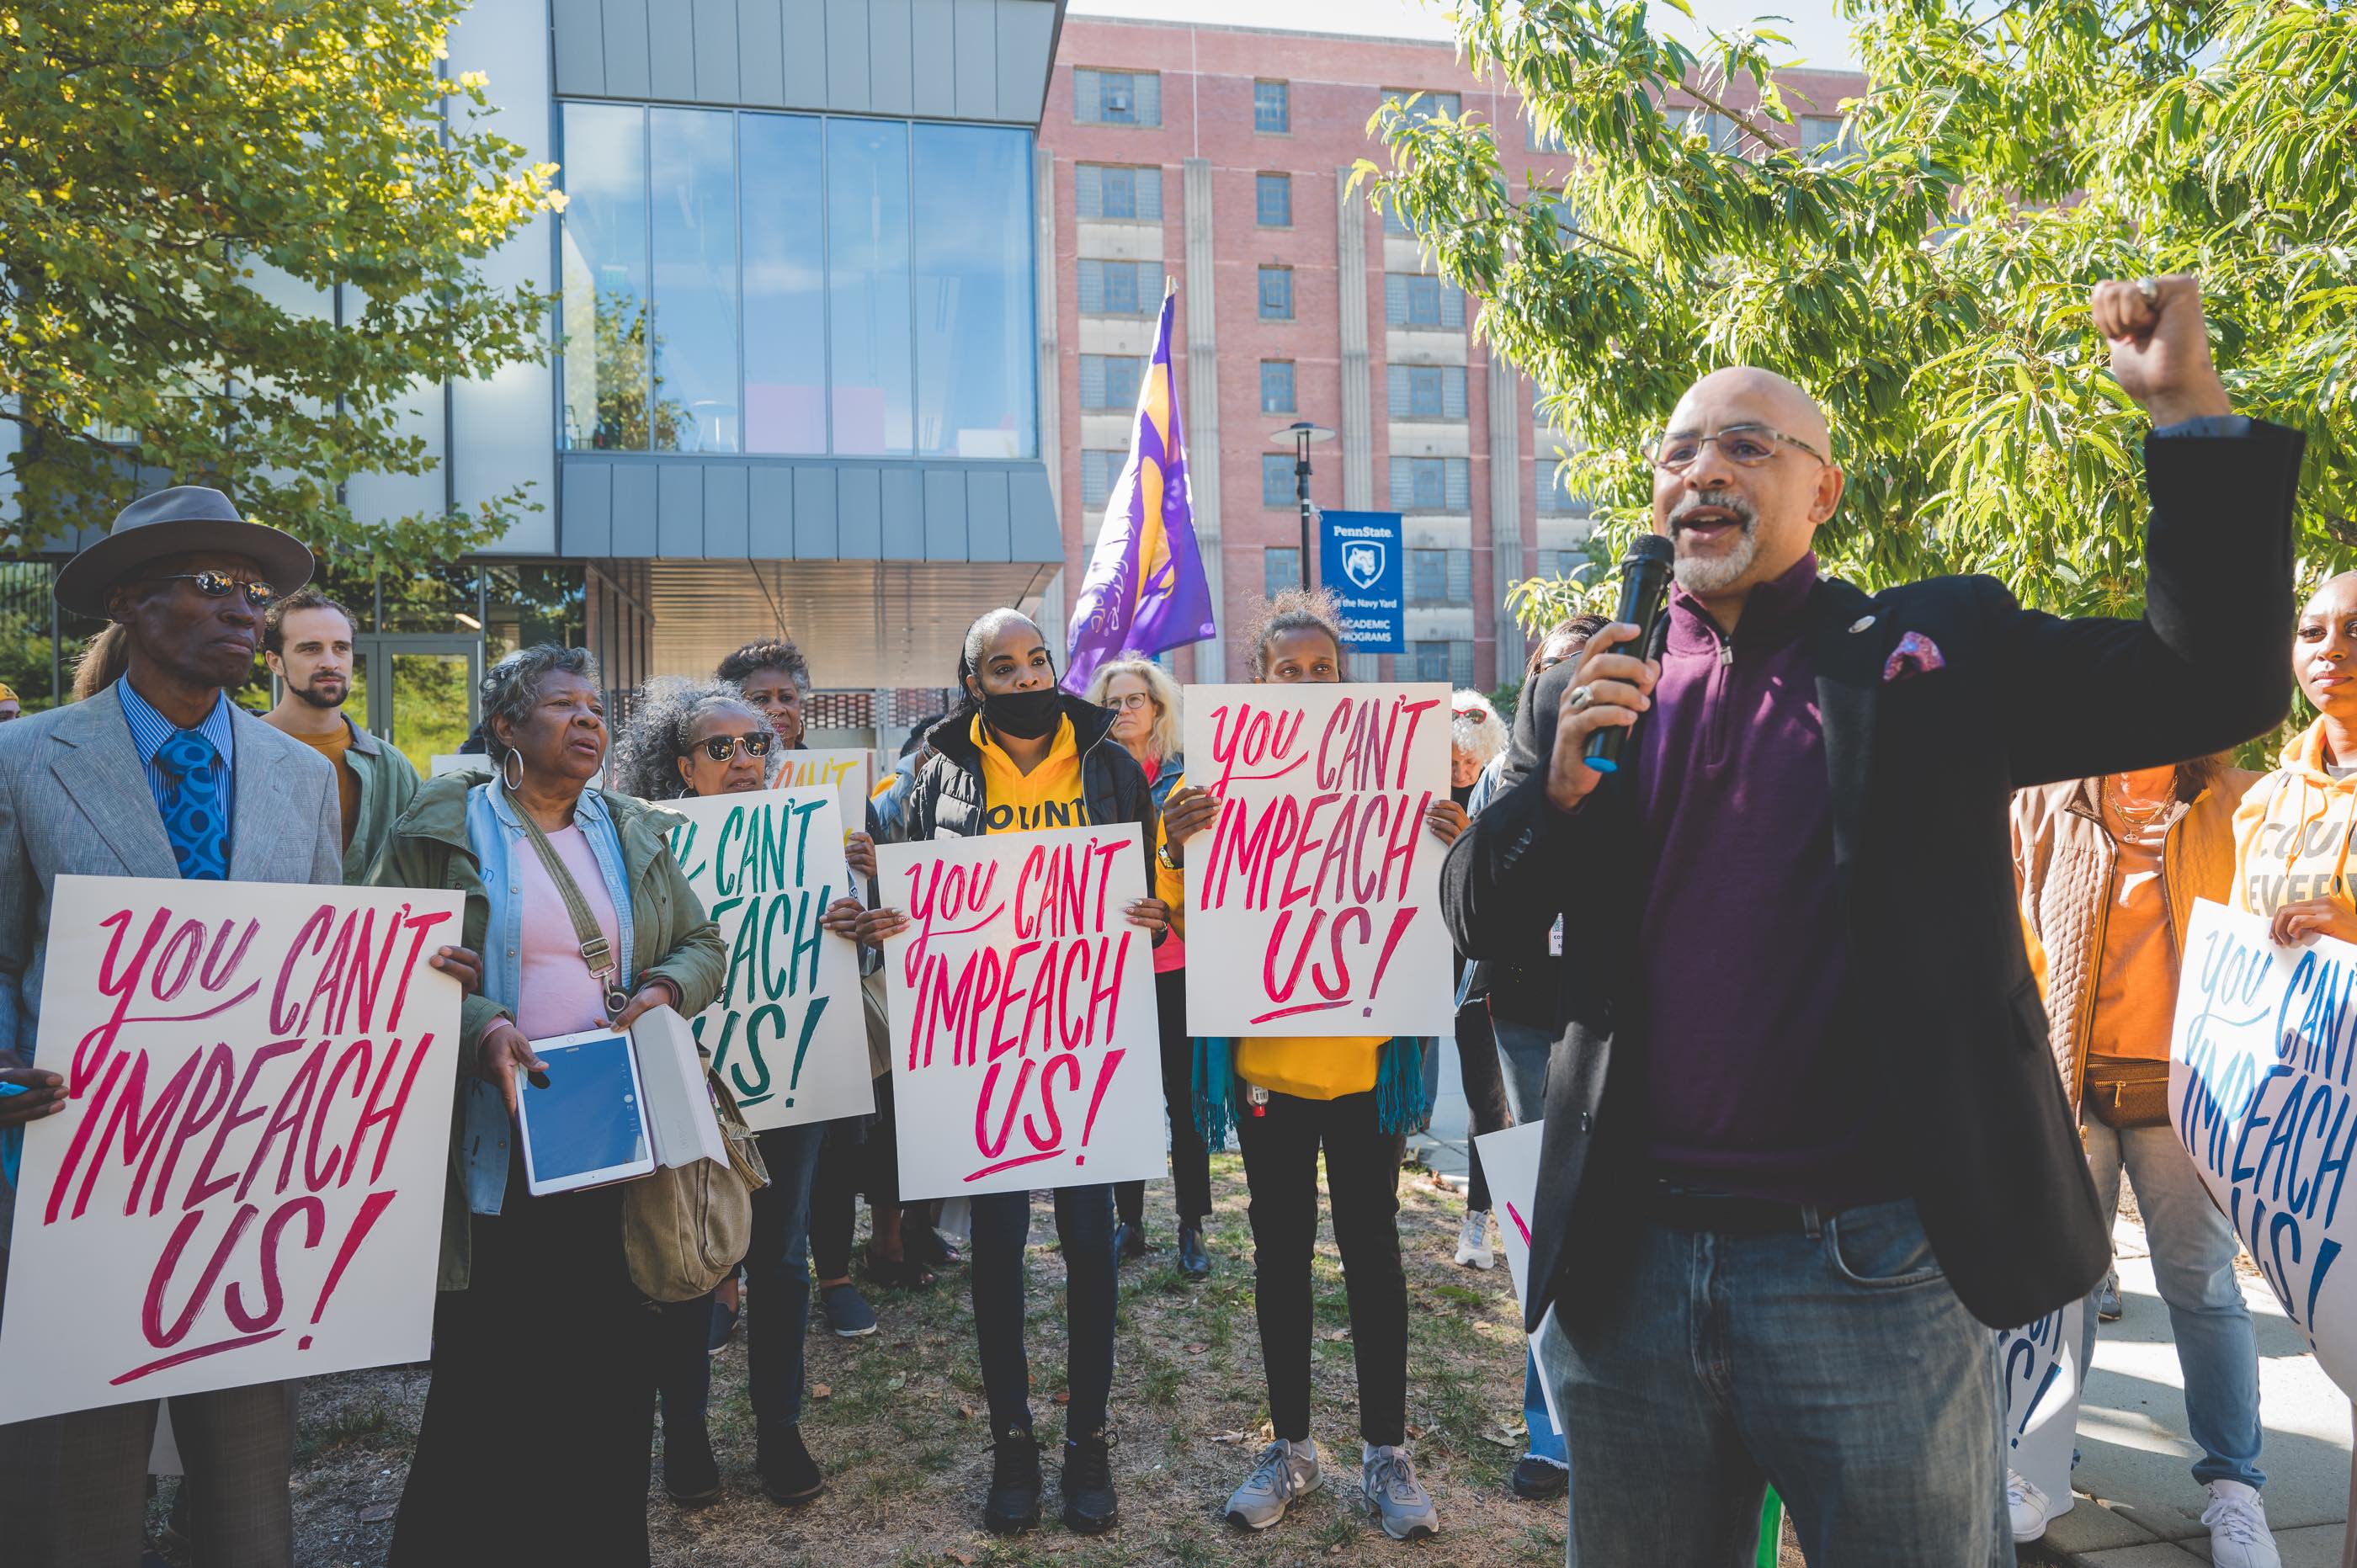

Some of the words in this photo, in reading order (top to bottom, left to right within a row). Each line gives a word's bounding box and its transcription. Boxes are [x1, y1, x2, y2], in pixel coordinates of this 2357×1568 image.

[1338, 631, 1392, 642] PROGRAMS
[1339, 619, 1391, 630] ACADEMIC
[1342, 598, 1356, 608] the
[1357, 598, 1379, 609] Navy
[1379, 598, 1397, 609] Yard
[987, 798, 1091, 830] OUNT
[1205, 703, 1309, 829] YOU
[1316, 694, 1441, 791] CAN'T
[716, 798, 828, 897] CAN'T
[1200, 791, 1433, 911] IMPEACH
[905, 858, 1007, 989] YOU
[1014, 837, 1132, 940] CAN'T
[1263, 906, 1418, 1018] US!
[69, 906, 262, 1099] YOU
[269, 902, 453, 1038] CAN'T
[908, 931, 1132, 1072] IMPEACH
[2185, 930, 2274, 1066] YOU
[43, 1032, 434, 1226] IMPEACH
[975, 1048, 1127, 1167] US!
[2181, 1038, 2357, 1230] IMPEACH
[141, 1189, 398, 1352] US!
